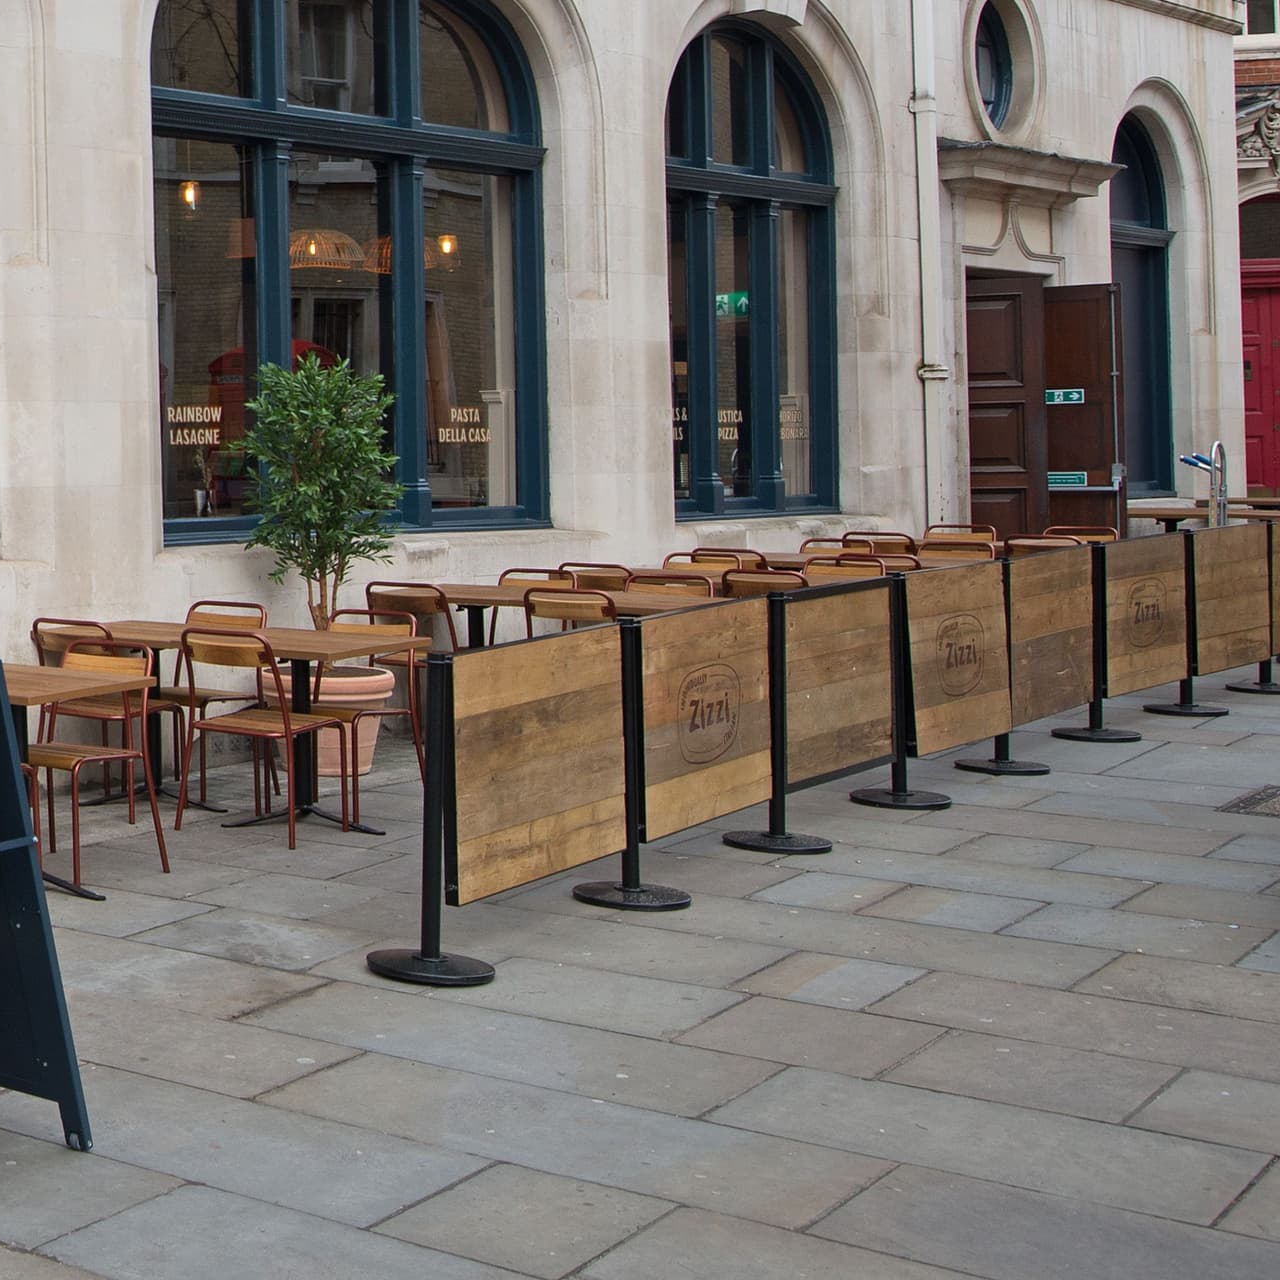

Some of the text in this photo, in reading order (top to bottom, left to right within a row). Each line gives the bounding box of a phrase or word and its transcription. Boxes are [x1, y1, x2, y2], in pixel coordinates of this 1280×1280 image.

[167, 405, 223, 424] RAINBOW
[450, 407, 481, 423] PASTA
[717, 409, 743, 423] USTICA
[169, 428, 221, 446] LASAGNE
[438, 427, 492, 443] DELLA CASA
[717, 426, 739, 440] PIZZA
[945, 638, 977, 670] Zizzi
[689, 691, 730, 733] Zizzi
